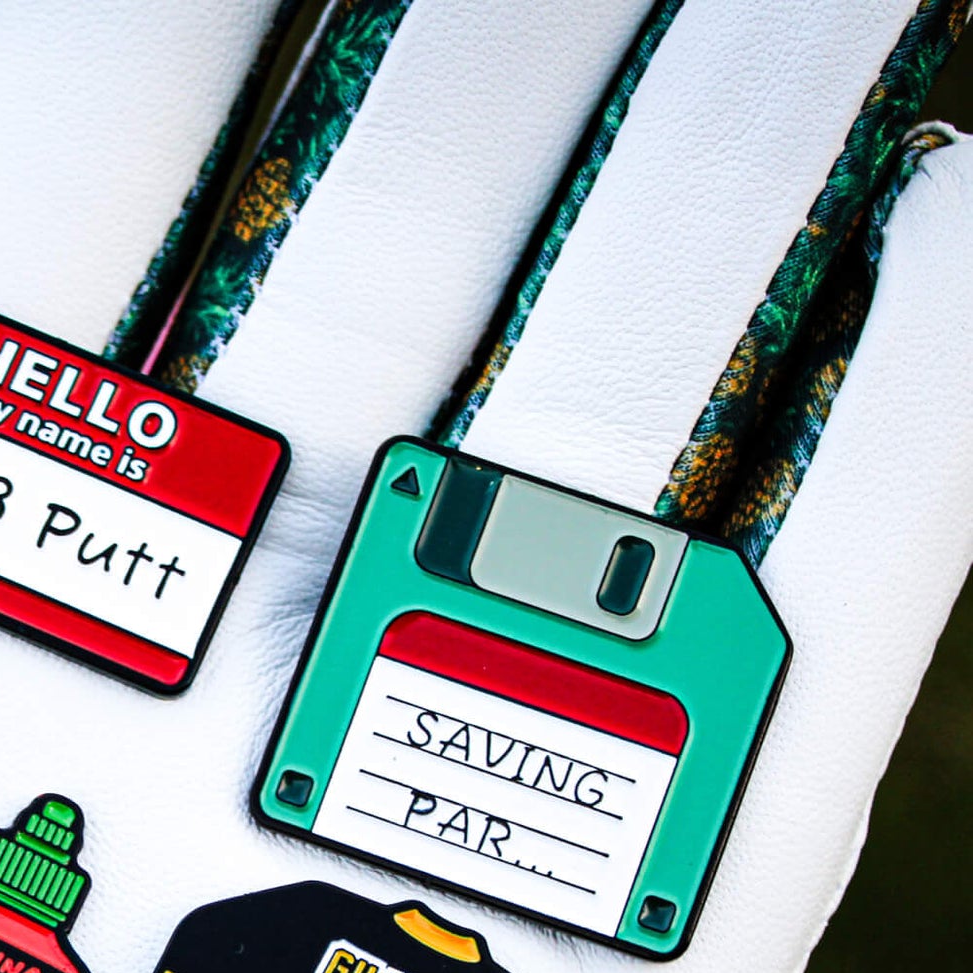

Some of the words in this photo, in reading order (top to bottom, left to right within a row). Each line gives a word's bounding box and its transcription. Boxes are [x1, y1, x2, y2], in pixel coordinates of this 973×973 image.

[17, 411, 111, 466] name
[114, 448, 148, 482] is
[35, 503, 187, 600] Putt
[407, 712, 609, 809] SAVING
